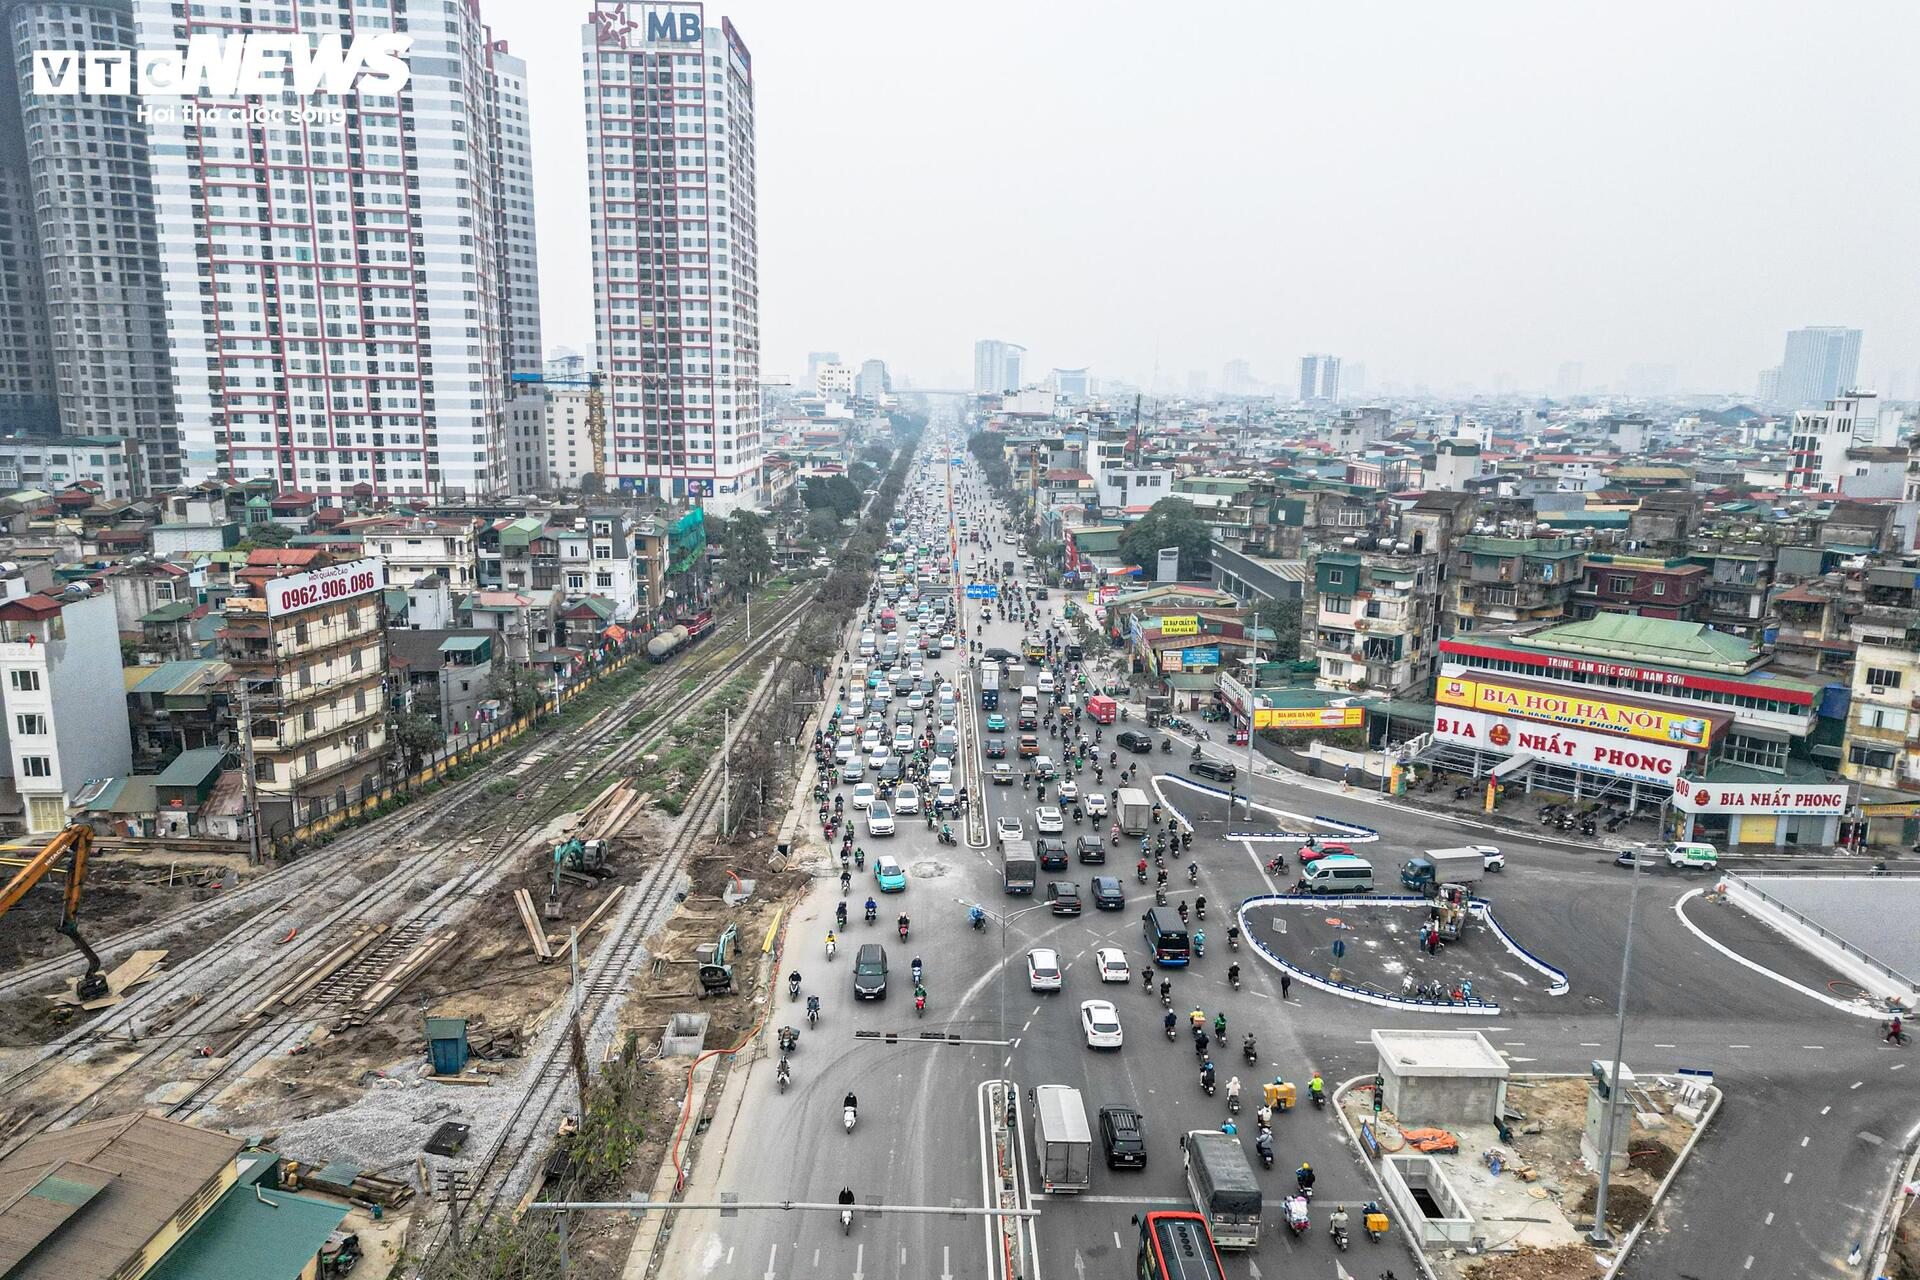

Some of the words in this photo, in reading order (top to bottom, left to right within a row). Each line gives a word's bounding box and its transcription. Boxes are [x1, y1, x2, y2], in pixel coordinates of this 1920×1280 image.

[648, 11, 701, 42] MB
[281, 571, 375, 610] 0962.906.086
[1548, 657, 1574, 669] TRUNG
[1577, 659, 1594, 672] TÂM
[1598, 663, 1616, 676] TIỆC
[1643, 671, 1663, 682] NAM
[1483, 688, 1519, 706] BIA
[1526, 695, 1568, 713] HƠI
[1576, 703, 1609, 721] HÀ
[1617, 710, 1663, 730] NỘI
[1589, 720, 1630, 733] PHONG
[1437, 718, 1476, 738] BIA
[1519, 733, 1577, 756] NHẤT
[1594, 746, 1672, 774] PHONG
[1676, 778, 1690, 797] 809
[1720, 793, 1745, 806] BIA
[1751, 787, 1790, 806] NHẤT
[1795, 794, 1842, 807] PHONG
